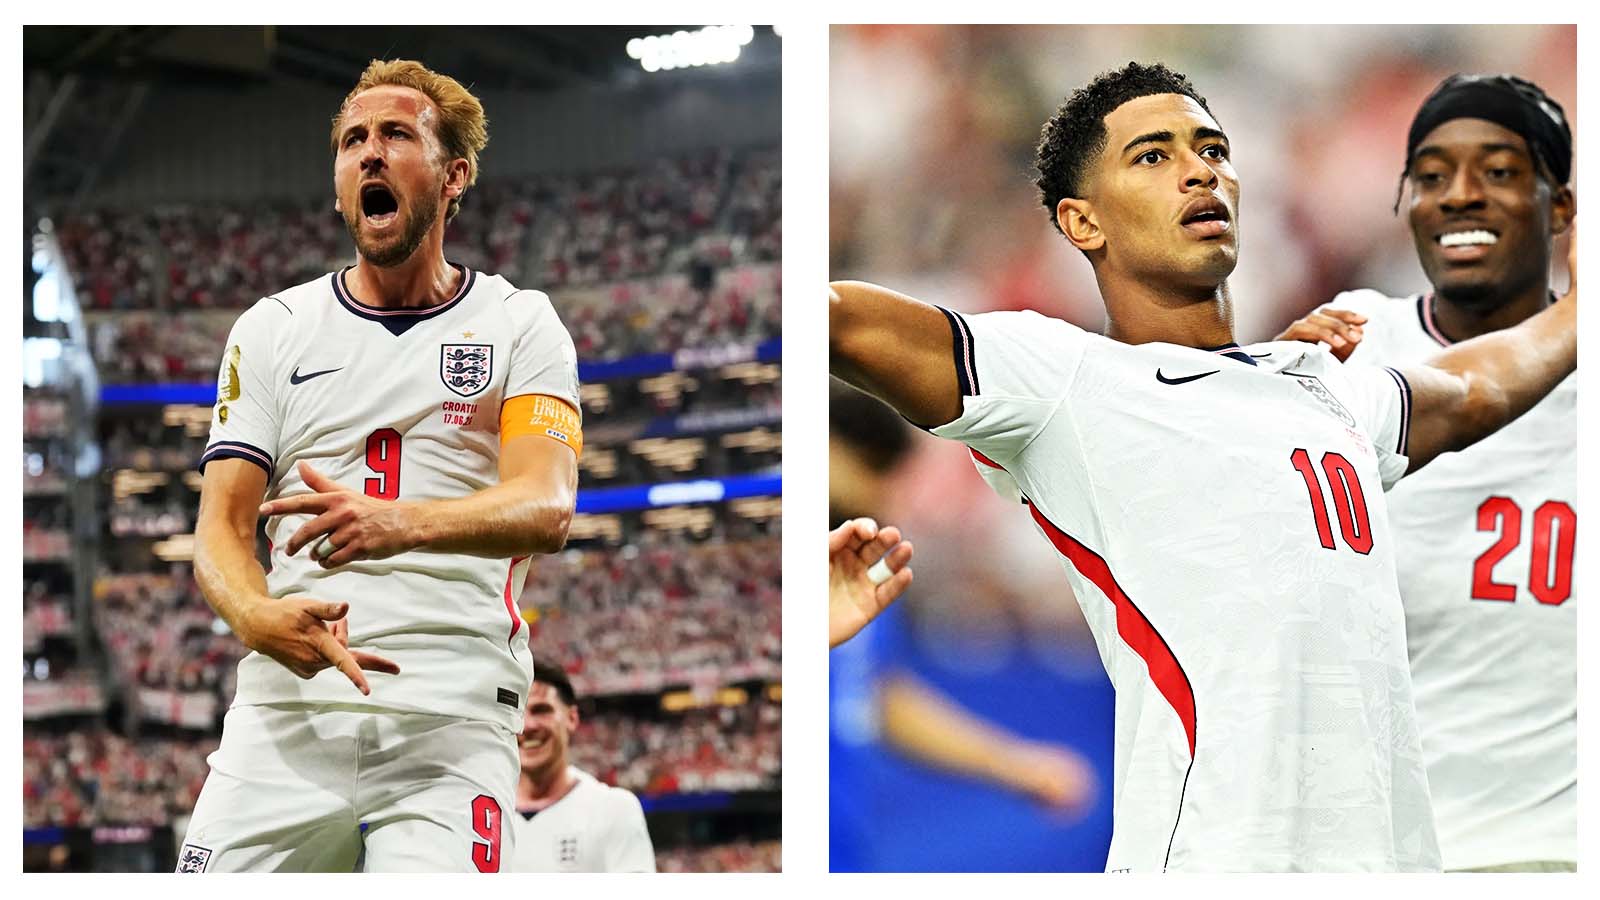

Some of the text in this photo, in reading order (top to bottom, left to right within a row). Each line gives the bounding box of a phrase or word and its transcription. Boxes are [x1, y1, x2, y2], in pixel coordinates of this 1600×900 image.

[364, 427, 402, 501] 9
[547, 429, 567, 441] FIFA
[1290, 447, 1374, 555] 10
[1470, 495, 1577, 607] 20
[471, 793, 502, 873] 9
